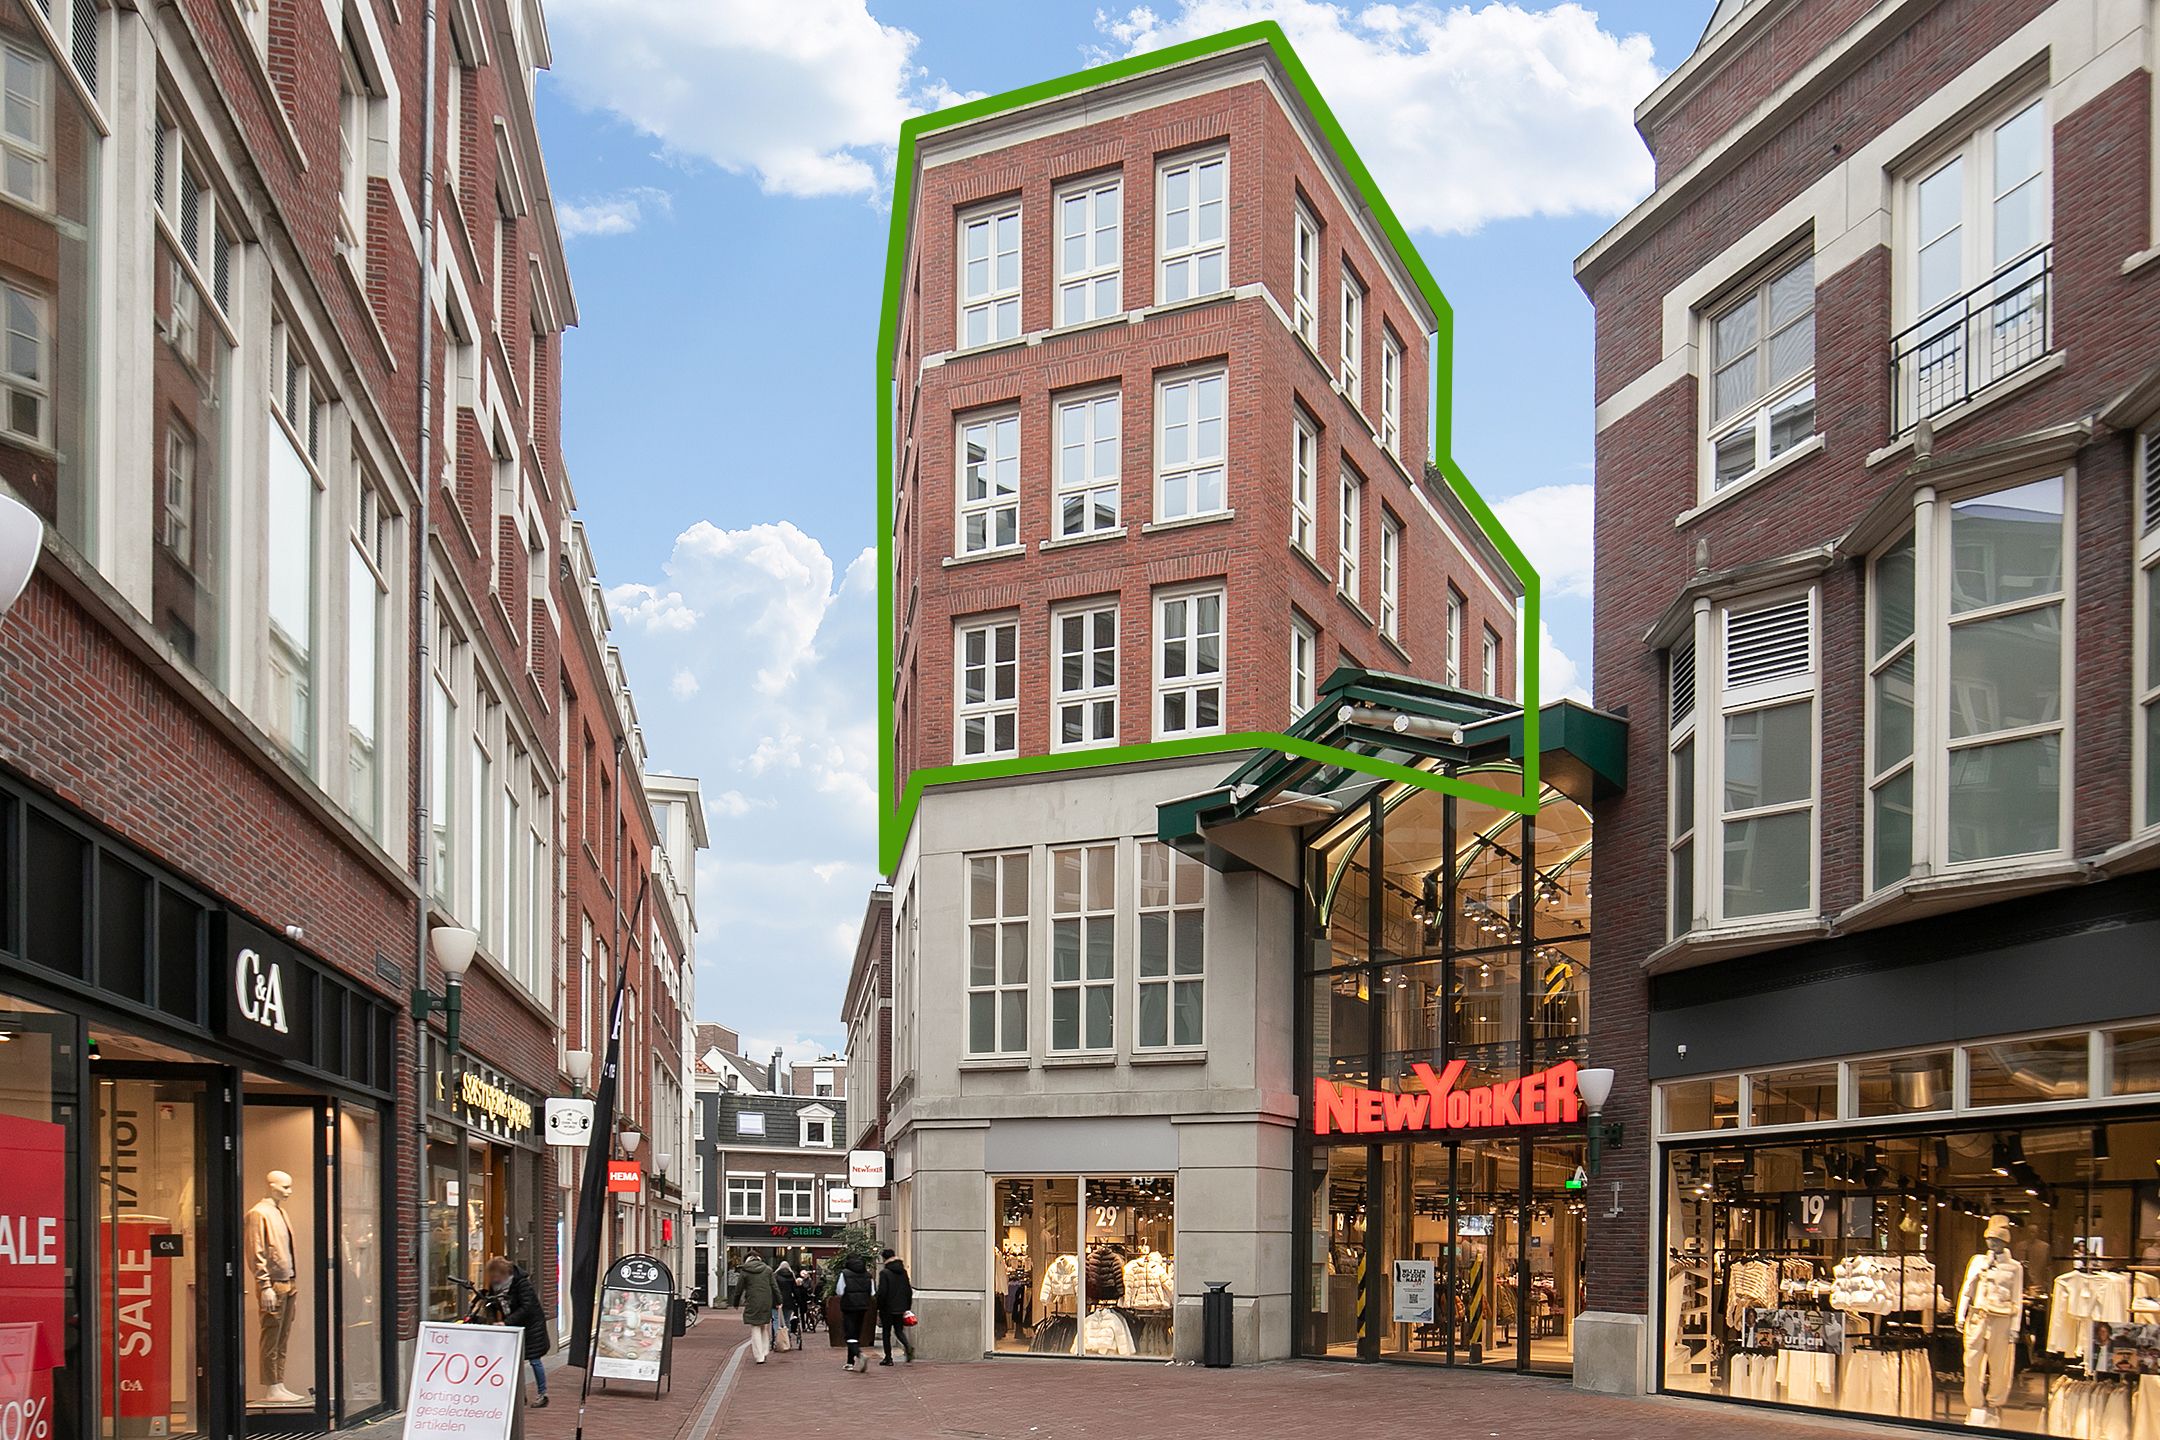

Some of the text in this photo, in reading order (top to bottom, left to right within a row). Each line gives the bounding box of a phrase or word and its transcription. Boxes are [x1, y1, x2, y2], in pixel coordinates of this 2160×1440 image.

[235, 948, 288, 1034] C&A
[610, 1171, 638, 1181] HEMA
[792, 1226, 822, 1236] stairs
[0, 1215, 57, 1265] ALE
[118, 1249, 152, 1357] SALE
[430, 1331, 449, 1344] Tot
[1784, 1333, 1823, 1346] urban
[425, 1351, 504, 1387] 70%
[419, 1388, 479, 1405] korting op
[0, 1396, 48, 1440] 0%
[416, 1404, 503, 1420] geselecteerde
[414, 1420, 466, 1432] artikelen
